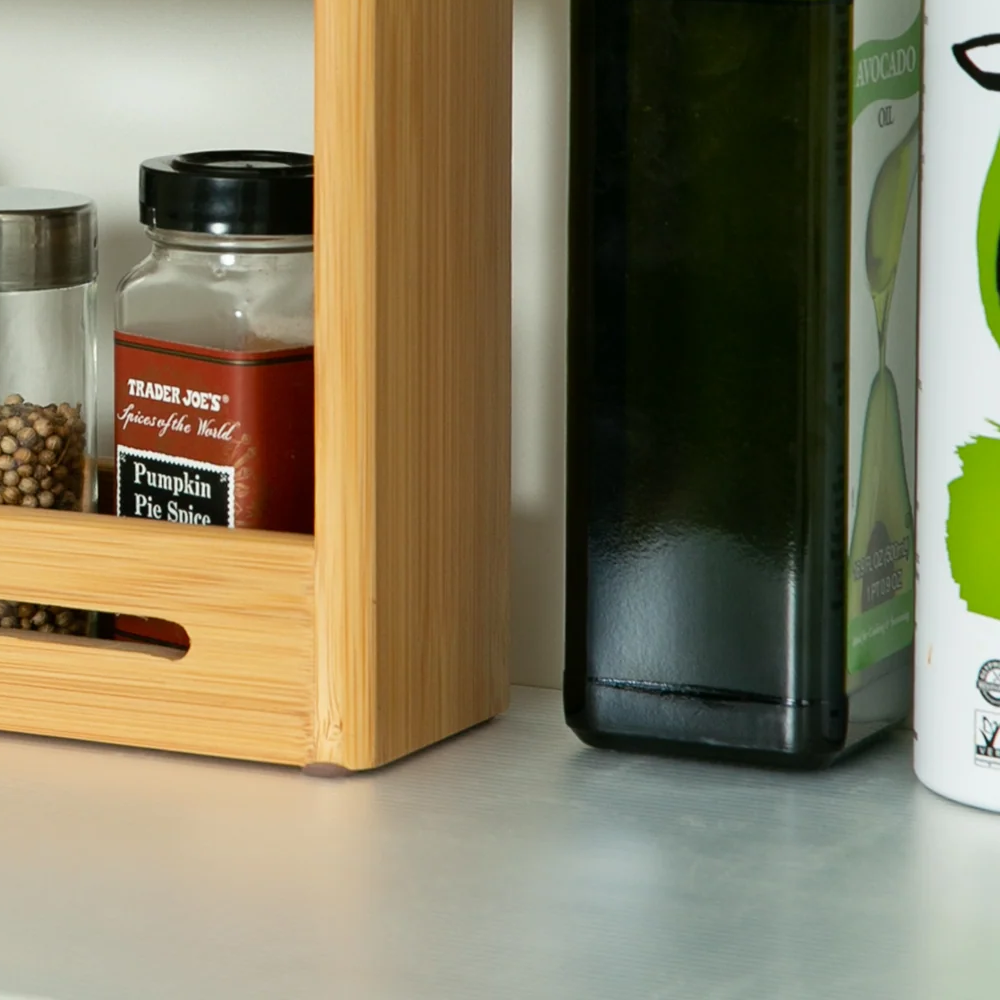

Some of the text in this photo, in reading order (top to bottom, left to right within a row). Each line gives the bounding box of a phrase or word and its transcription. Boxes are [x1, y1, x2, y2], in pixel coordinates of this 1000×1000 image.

[855, 45, 916, 88] AVOCADO
[878, 105, 894, 128] OIL
[127, 378, 181, 405] TRADER
[117, 403, 241, 441] Spices of the World
[133, 461, 211, 499] Pumpkin
[134, 492, 211, 526] Pie Spice
